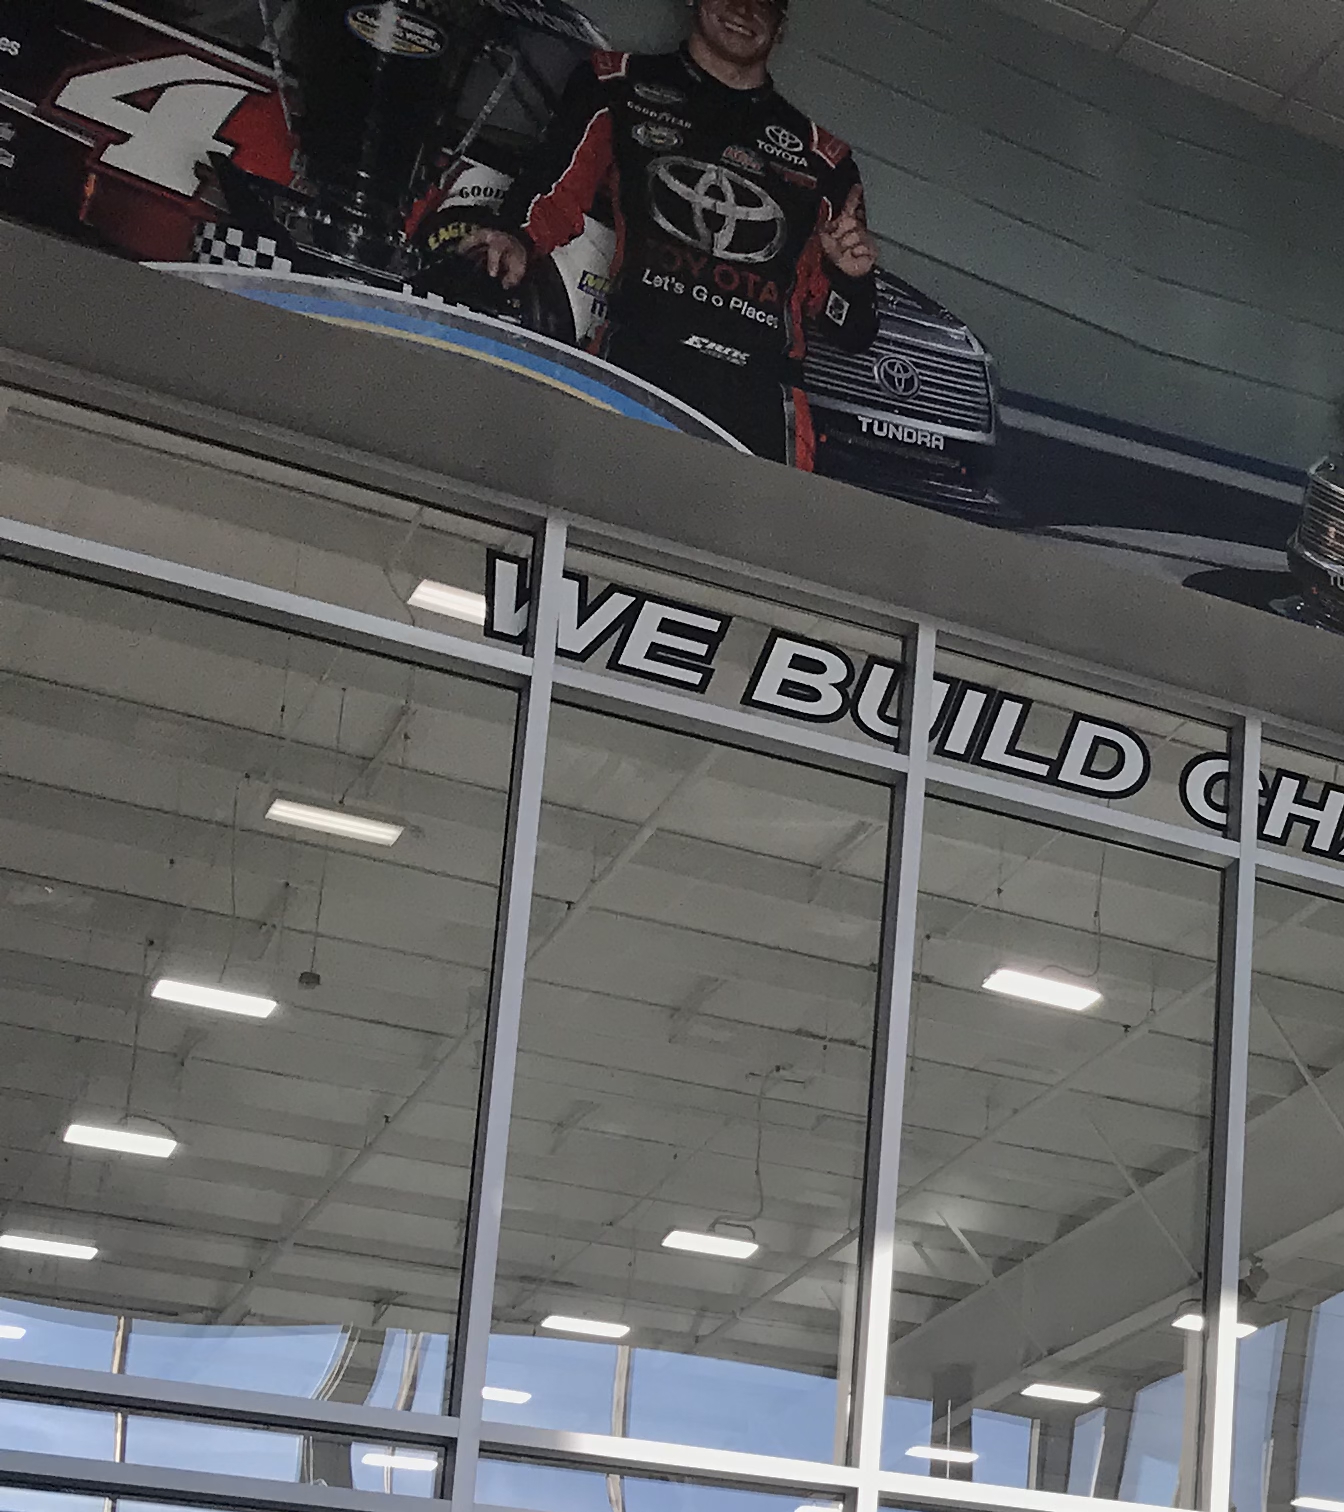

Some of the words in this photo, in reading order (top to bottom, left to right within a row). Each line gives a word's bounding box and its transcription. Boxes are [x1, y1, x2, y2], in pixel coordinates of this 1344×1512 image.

[54, 53, 271, 197] 4
[756, 139, 808, 168] TOYOTA
[642, 267, 685, 295] Let's
[691, 283, 725, 308] Go
[857, 415, 945, 451] TUNDRA
[485, 547, 733, 695] WE
[740, 627, 1153, 800] BUILD
